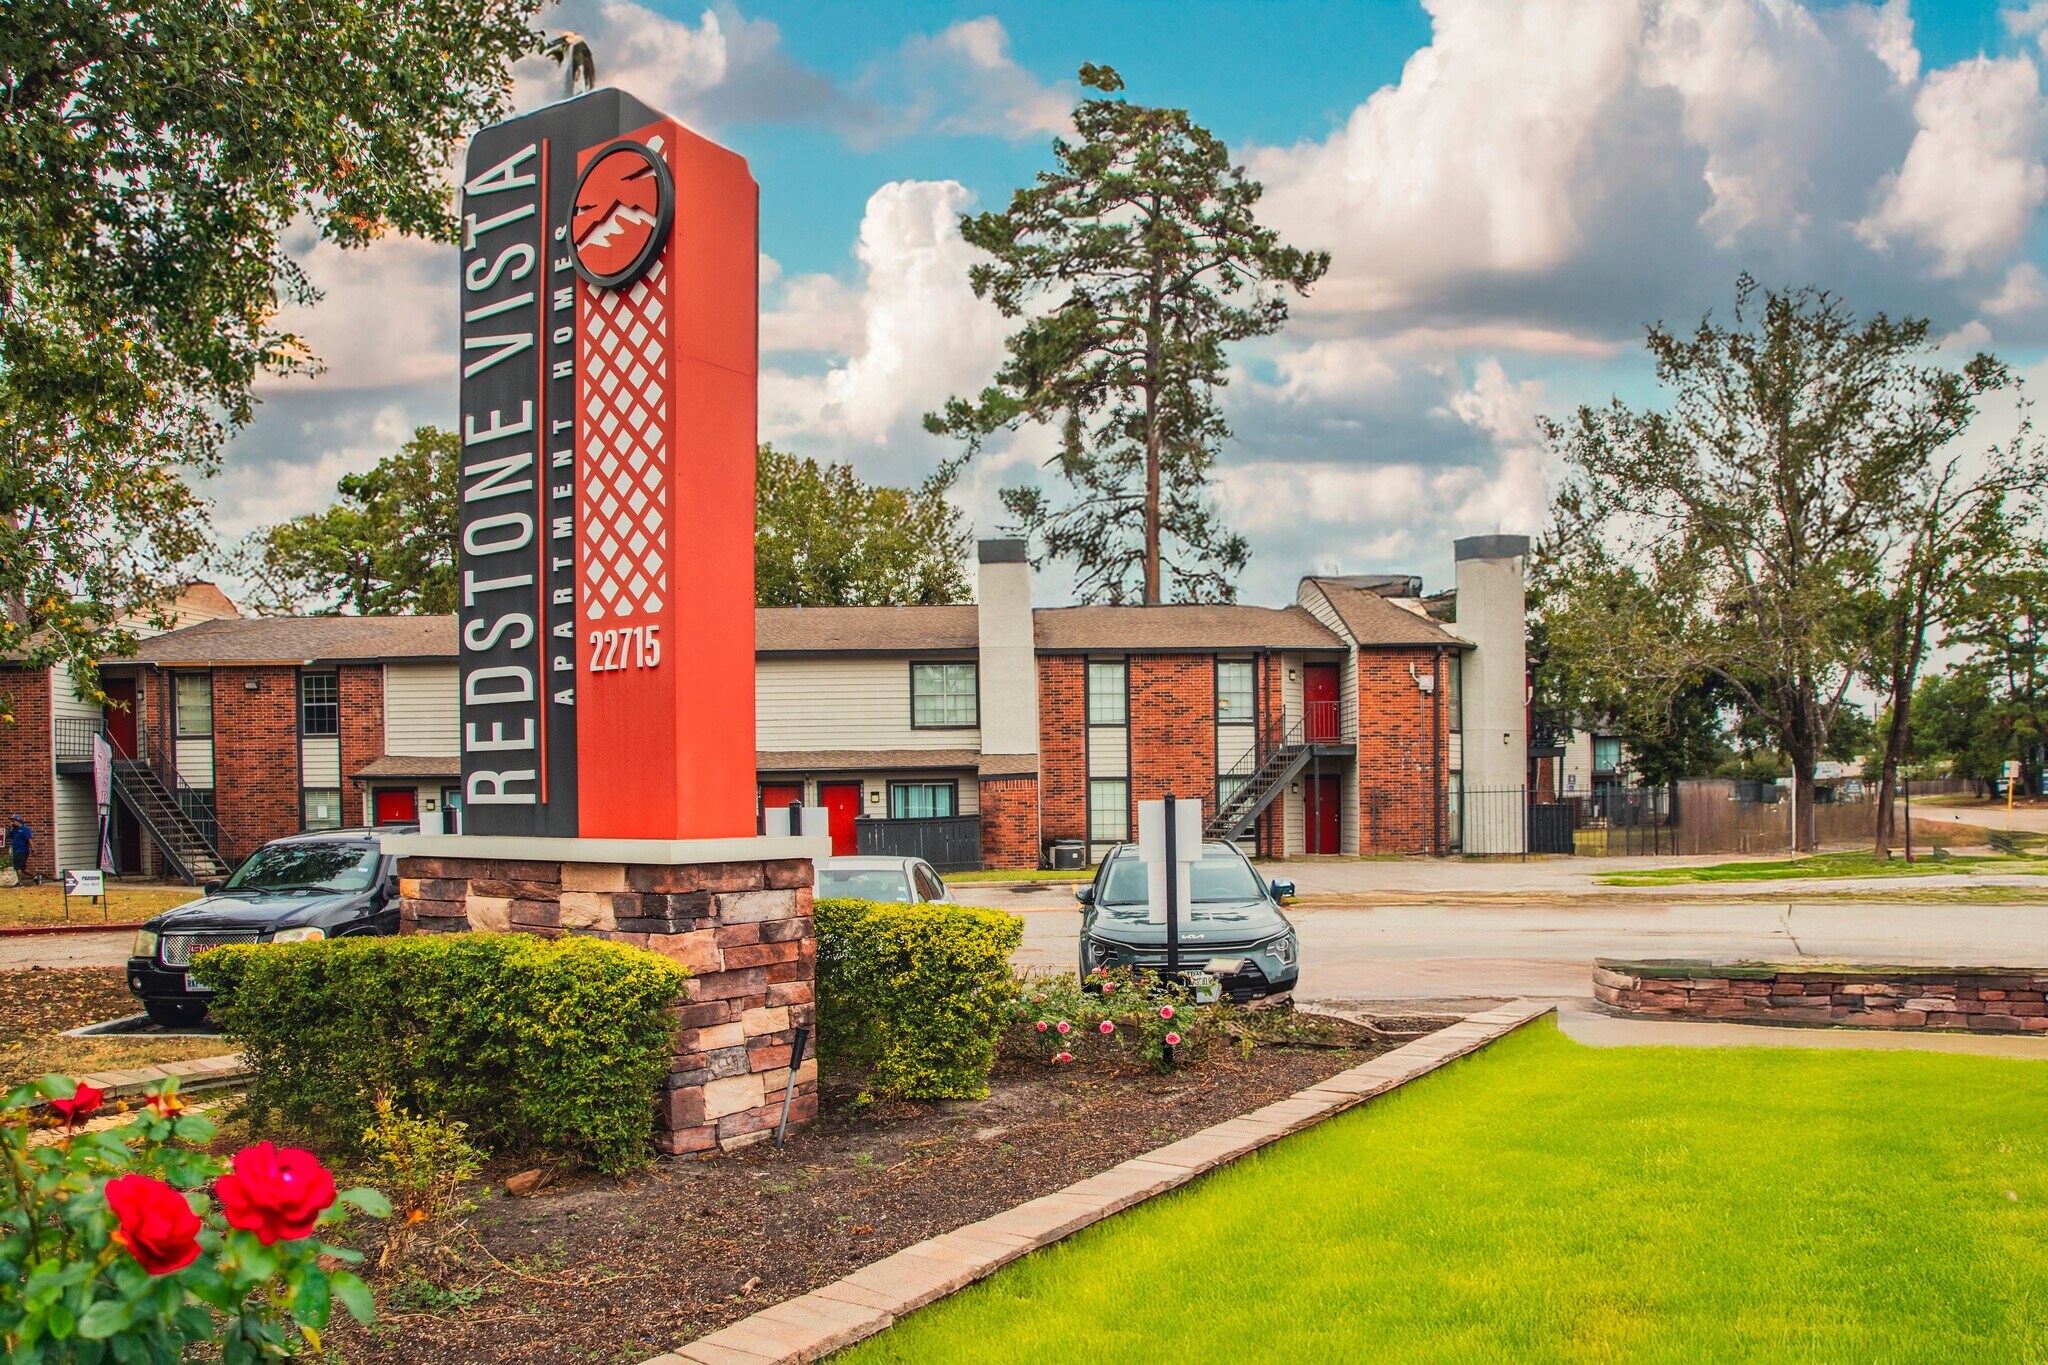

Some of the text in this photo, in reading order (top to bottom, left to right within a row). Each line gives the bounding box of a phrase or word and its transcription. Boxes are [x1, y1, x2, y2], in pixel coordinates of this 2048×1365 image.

[464, 142, 537, 805] REDSTONE VISTA
[552, 419, 575, 706] APARTMENT
[589, 624, 662, 673] 22715
[188, 943, 221, 953] GM
